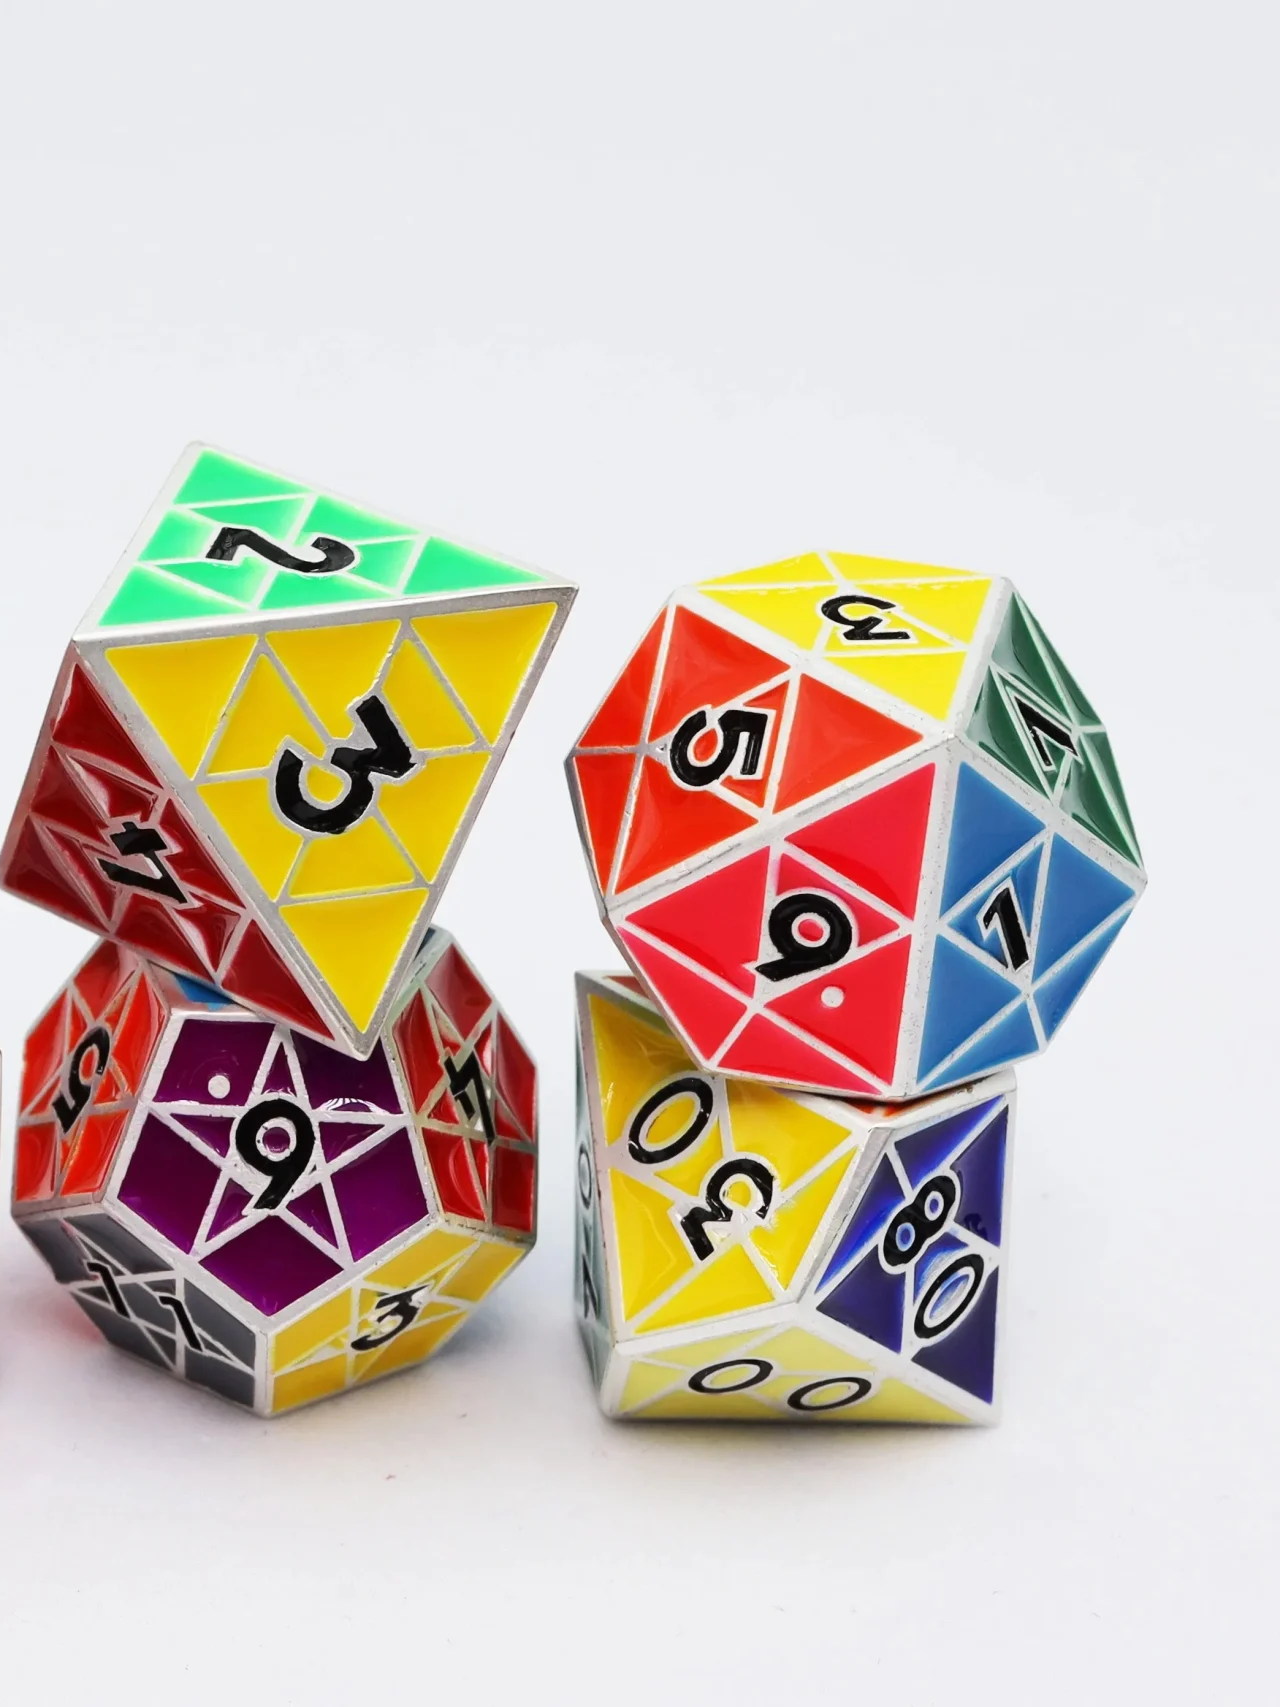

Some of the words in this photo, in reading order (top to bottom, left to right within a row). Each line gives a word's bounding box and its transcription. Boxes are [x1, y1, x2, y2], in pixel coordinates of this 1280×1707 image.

[205, 527, 355, 573] 2
[821, 595, 910, 641] 3
[275, 695, 417, 835] 3
[669, 709, 768, 787] 5
[1014, 696, 1078, 767] 7
[97, 821, 188, 904] 4
[755, 893, 853, 982] 9
[982, 887, 1029, 971] 1
[52, 1027, 110, 1134] 5
[443, 1051, 496, 1147] 4
[881, 1169, 986, 1339] 80
[86, 1261, 204, 1353] 11
[351, 1286, 425, 1351] 3
[688, 1359, 872, 1412] 00
